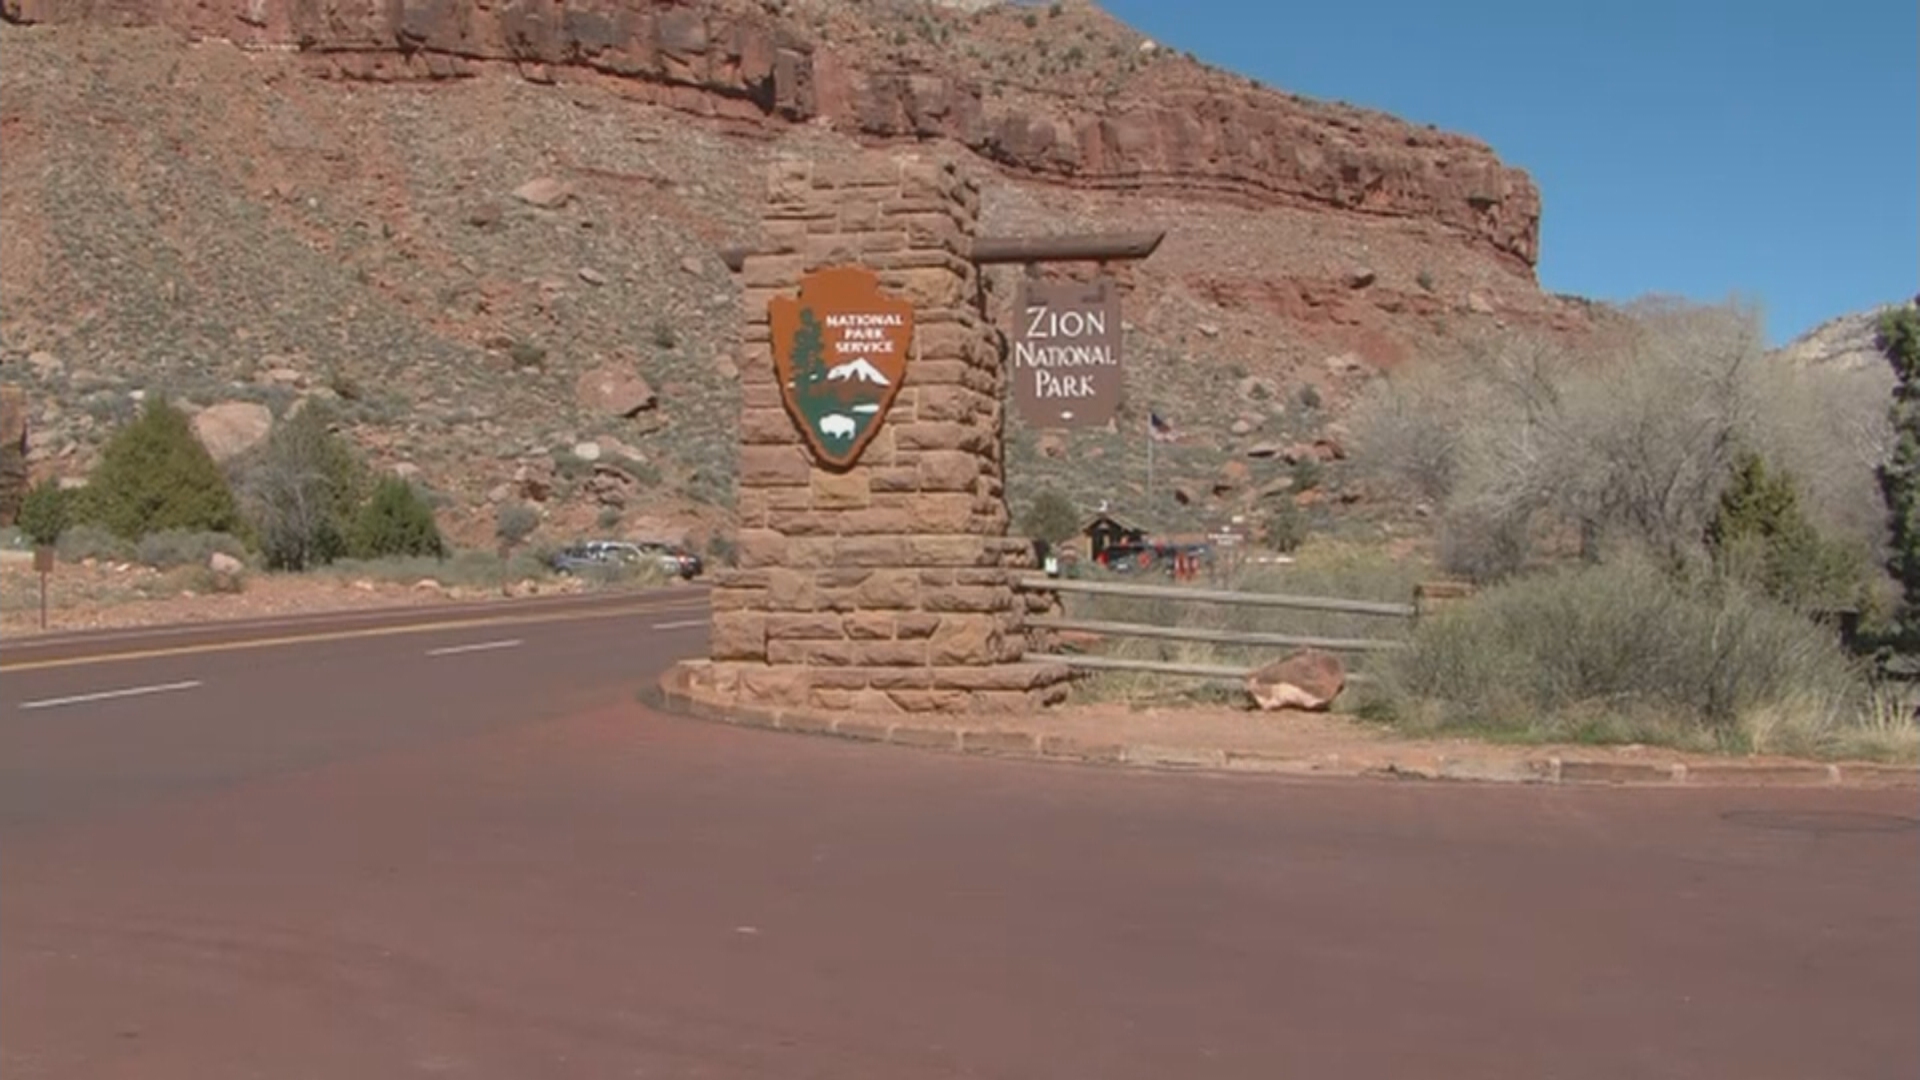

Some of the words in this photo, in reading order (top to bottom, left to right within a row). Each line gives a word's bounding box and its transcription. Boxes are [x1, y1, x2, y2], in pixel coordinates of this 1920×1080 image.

[826, 314, 903, 326] NATIONAL
[1025, 306, 1105, 337] ZION
[834, 329, 883, 340] PARK
[835, 342, 893, 353] SERVICE
[1015, 342, 1117, 368] NATIONAL
[1035, 370, 1095, 399] PARK
